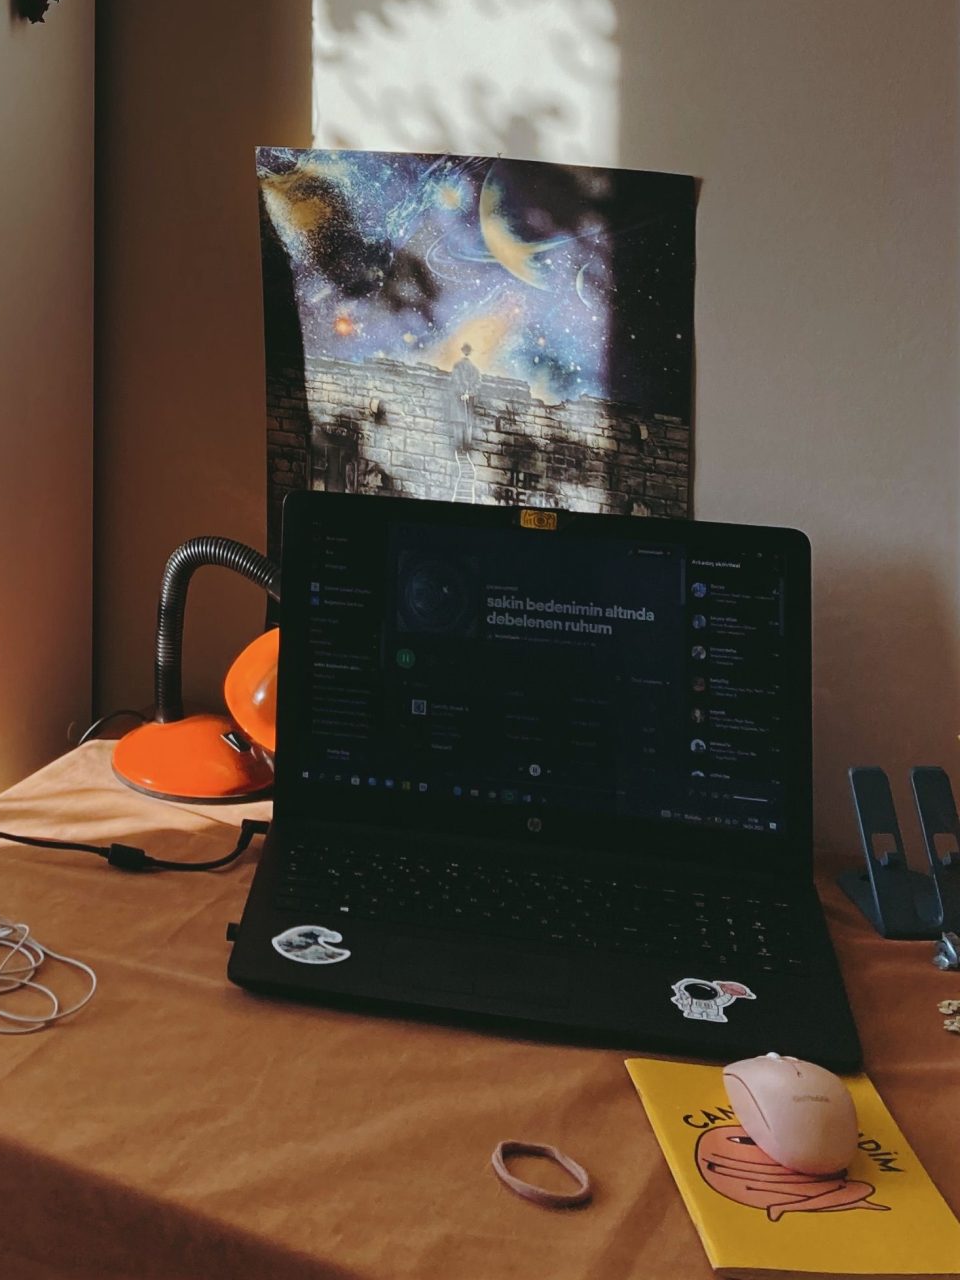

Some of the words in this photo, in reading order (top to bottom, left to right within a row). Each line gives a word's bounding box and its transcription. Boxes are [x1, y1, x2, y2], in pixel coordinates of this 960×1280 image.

[486, 595, 524, 612] sakin
[525, 597, 604, 618] bedenimin
[604, 604, 656, 623] altında
[486, 612, 564, 632] debelenen
[564, 618, 613, 636] ruhum
